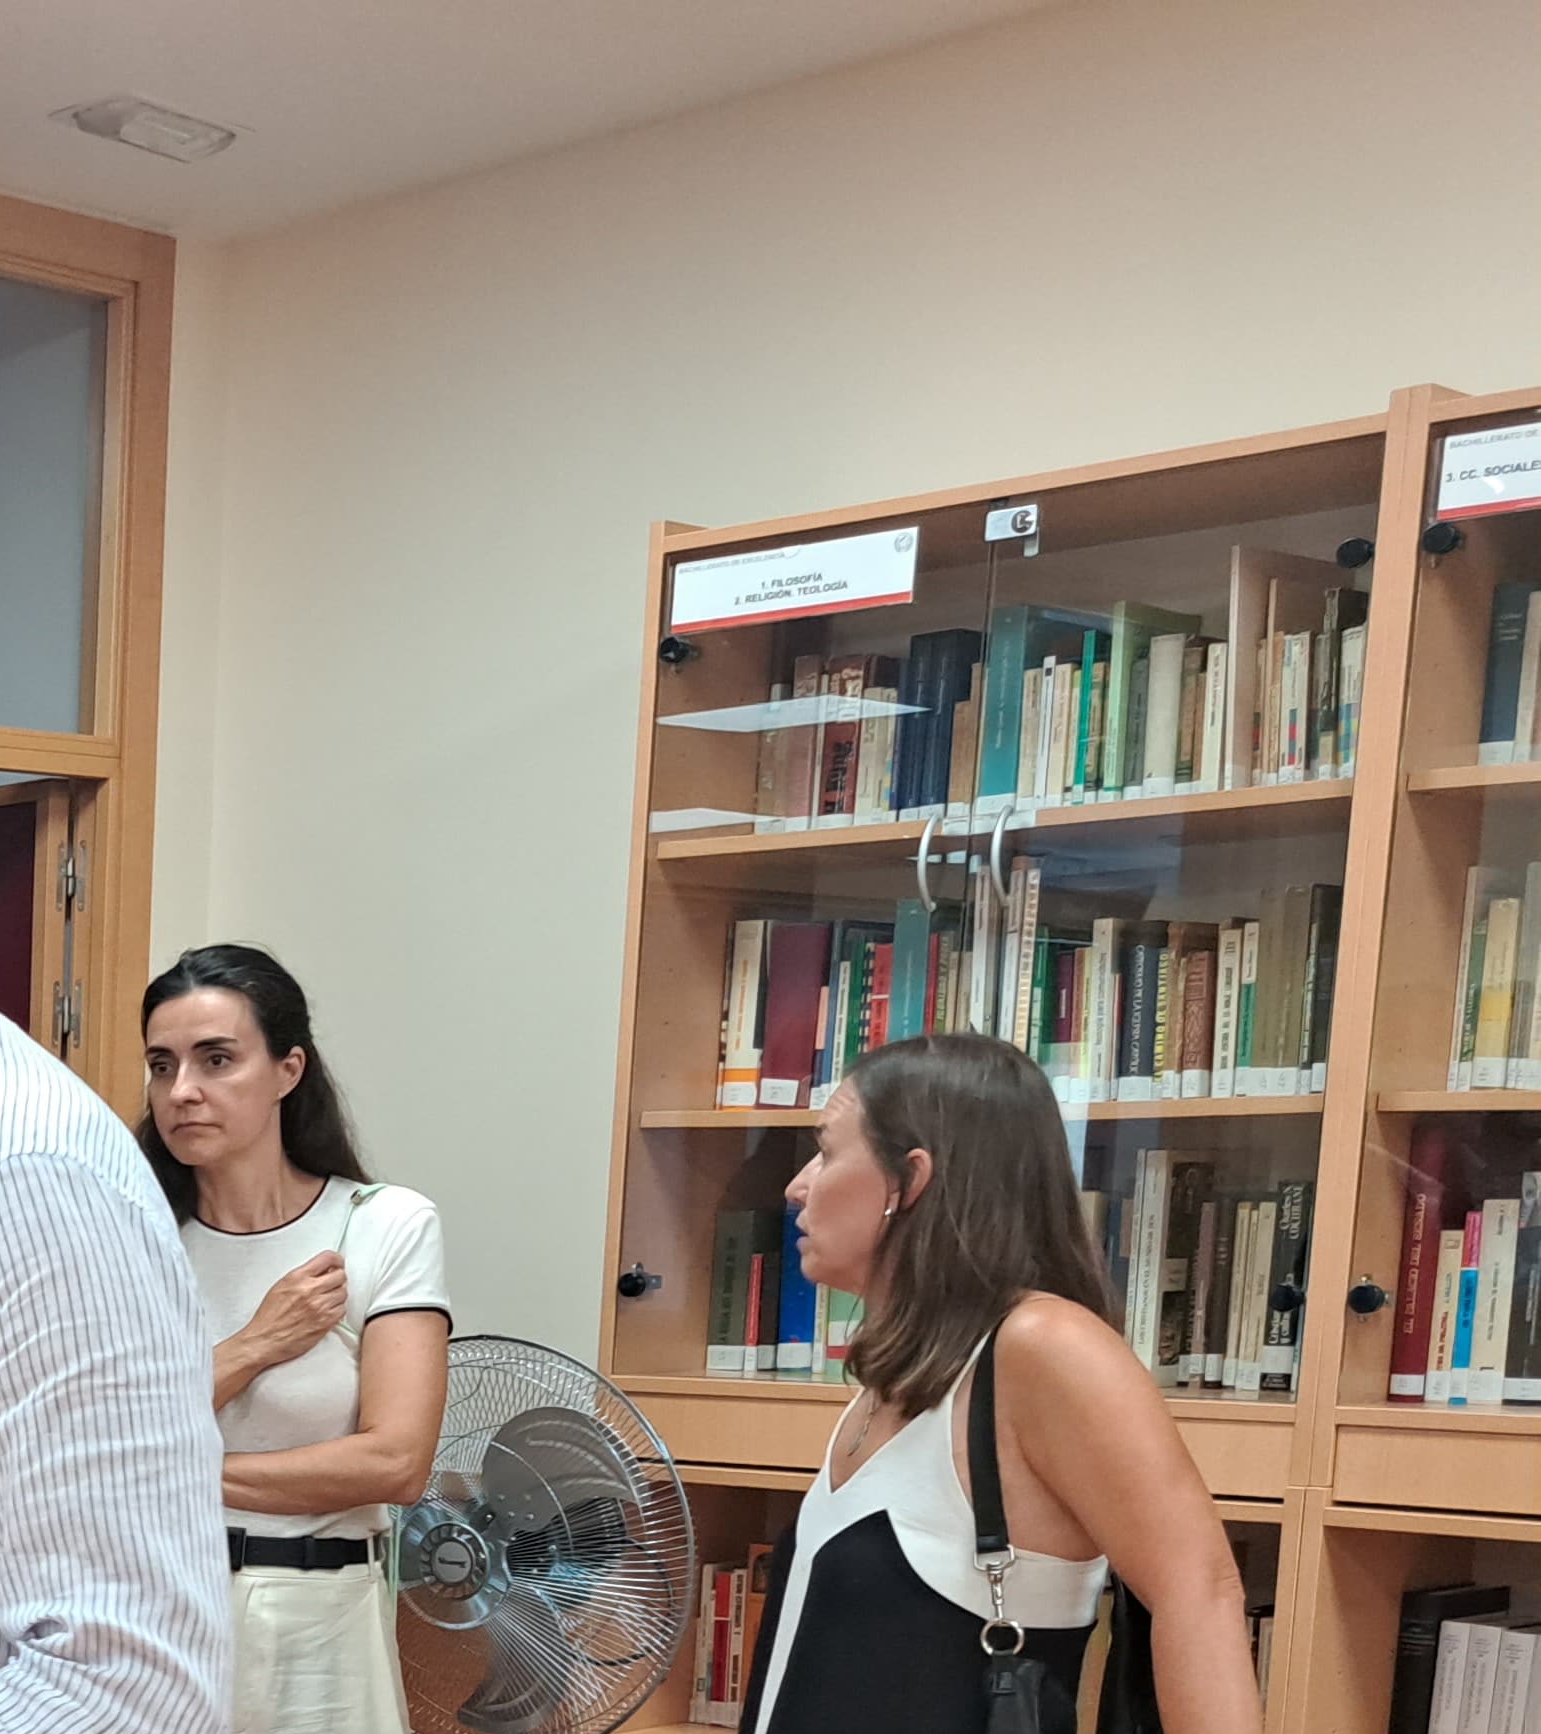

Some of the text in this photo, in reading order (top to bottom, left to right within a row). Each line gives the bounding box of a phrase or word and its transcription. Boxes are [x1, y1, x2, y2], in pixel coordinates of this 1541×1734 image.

[1483, 459, 1541, 477] SOCIALE
[771, 572, 823, 589] FILOSOFÍA
[797, 579, 849, 596] TEOLOGÍA
[1153, 1026, 1166, 1067] CAMINO
[1413, 1193, 1427, 1241] SENADO
[1410, 1244, 1421, 1266] DEL
[1404, 1317, 1415, 1334] EL
